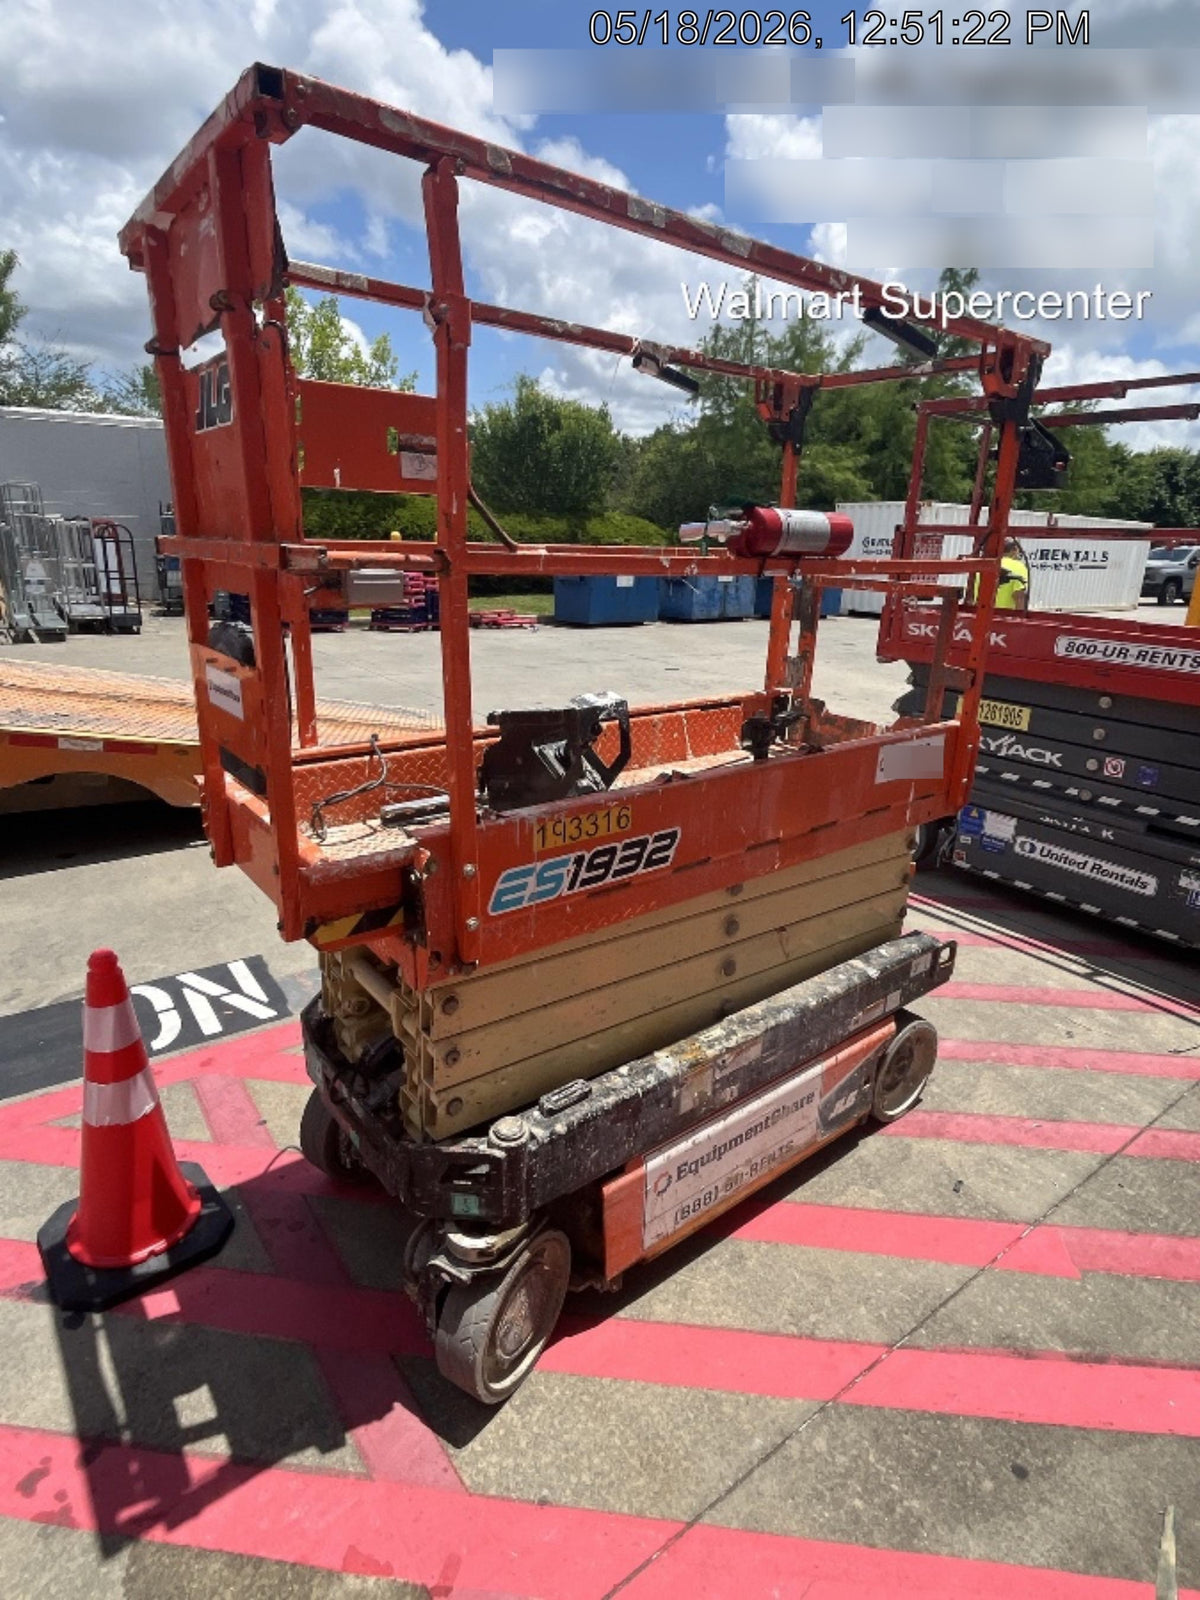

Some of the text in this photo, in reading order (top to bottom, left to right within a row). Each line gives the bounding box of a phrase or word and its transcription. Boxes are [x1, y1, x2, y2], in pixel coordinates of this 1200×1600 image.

[536, 806, 631, 849] 193316
[488, 828, 681, 915] ES1932
[1040, 845, 1150, 890] United Rentals
[675, 1091, 815, 1183] EquipmentShare
